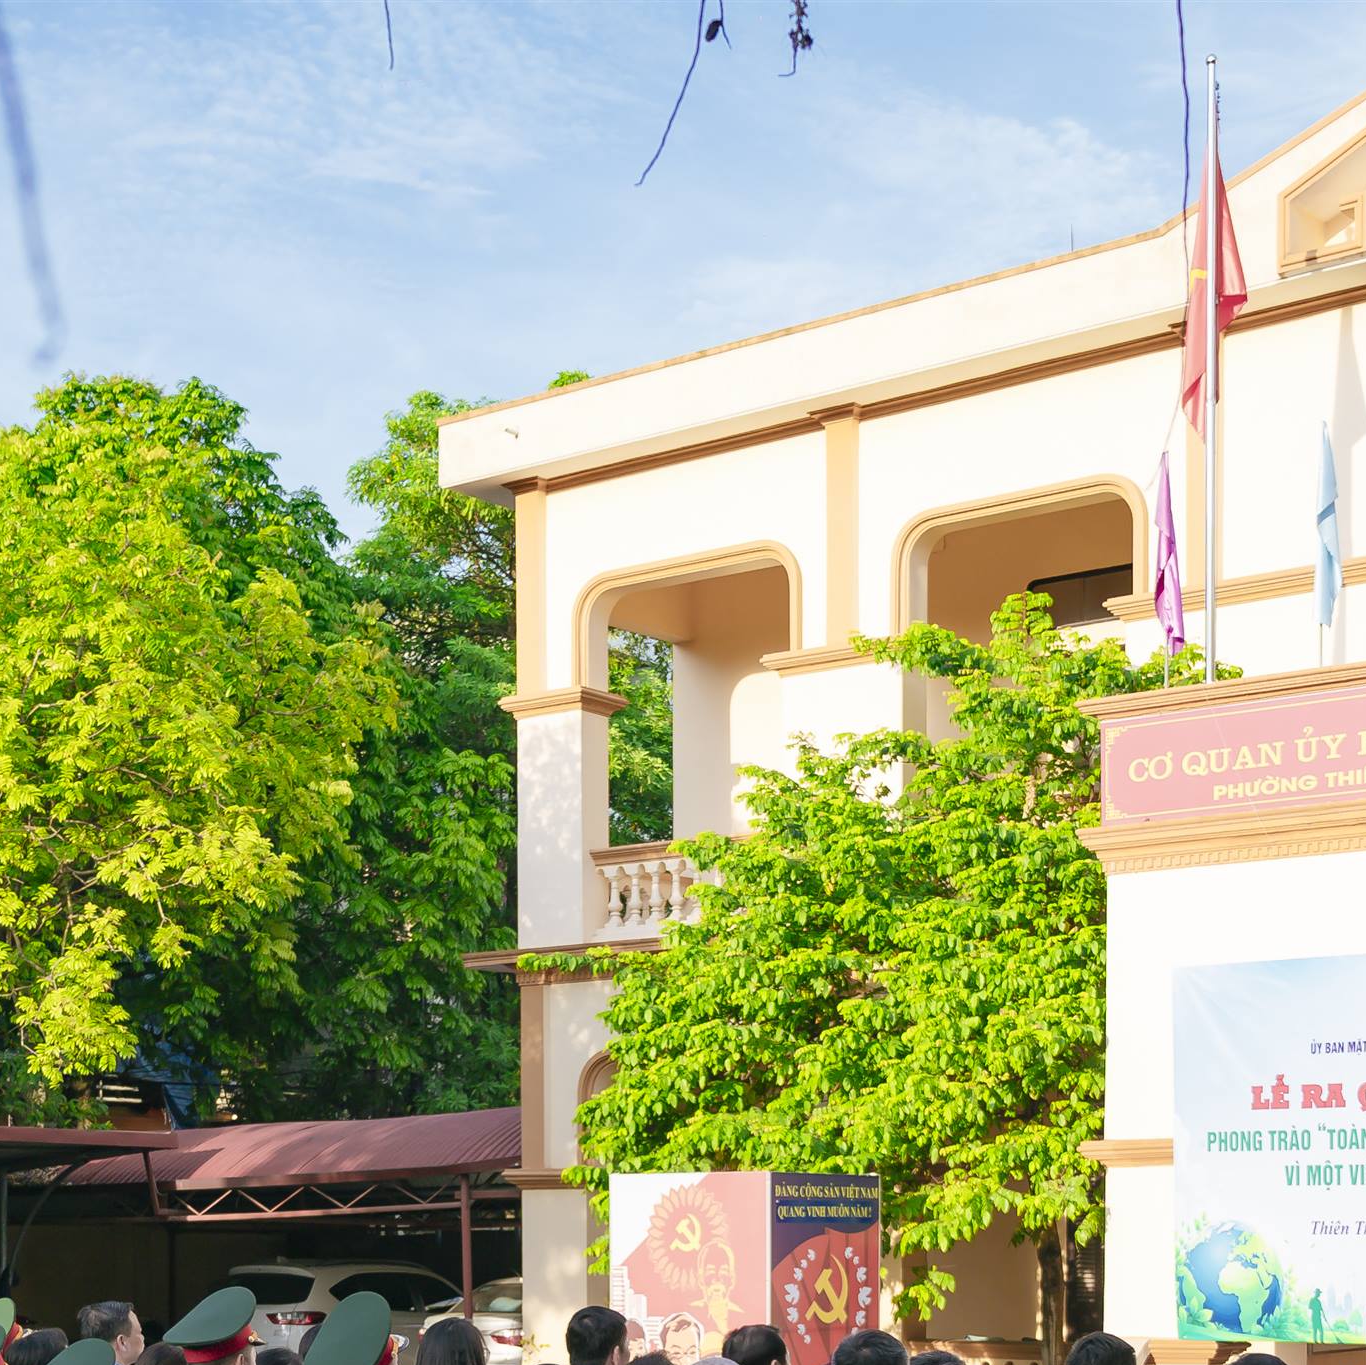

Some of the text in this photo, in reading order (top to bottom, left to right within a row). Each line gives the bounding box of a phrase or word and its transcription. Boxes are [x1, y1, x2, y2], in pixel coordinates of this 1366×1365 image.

[1128, 751, 1173, 783] CƠ
[1181, 741, 1286, 778] QUAN
[1294, 725, 1347, 763] ỦY
[1213, 774, 1318, 801] PHƯỜNG
[1325, 1041, 1344, 1054] BAN
[1251, 1074, 1290, 1110] LỄ
[1301, 1083, 1346, 1109] RA
[1207, 1131, 1263, 1152] PHONG
[1268, 1125, 1311, 1151] TRÀO
[1285, 1160, 1300, 1186] VÌ
[1307, 1160, 1343, 1190] MỘT
[775, 1181, 879, 1201] ĐẢNG CỘNG SẢN VIỆT NAM
[777, 1206, 805, 1220] QUANG
[807, 1206, 826, 1217] VINH
[827, 1203, 850, 1218] MUÔN
[1311, 1220, 1349, 1235] Thiên
